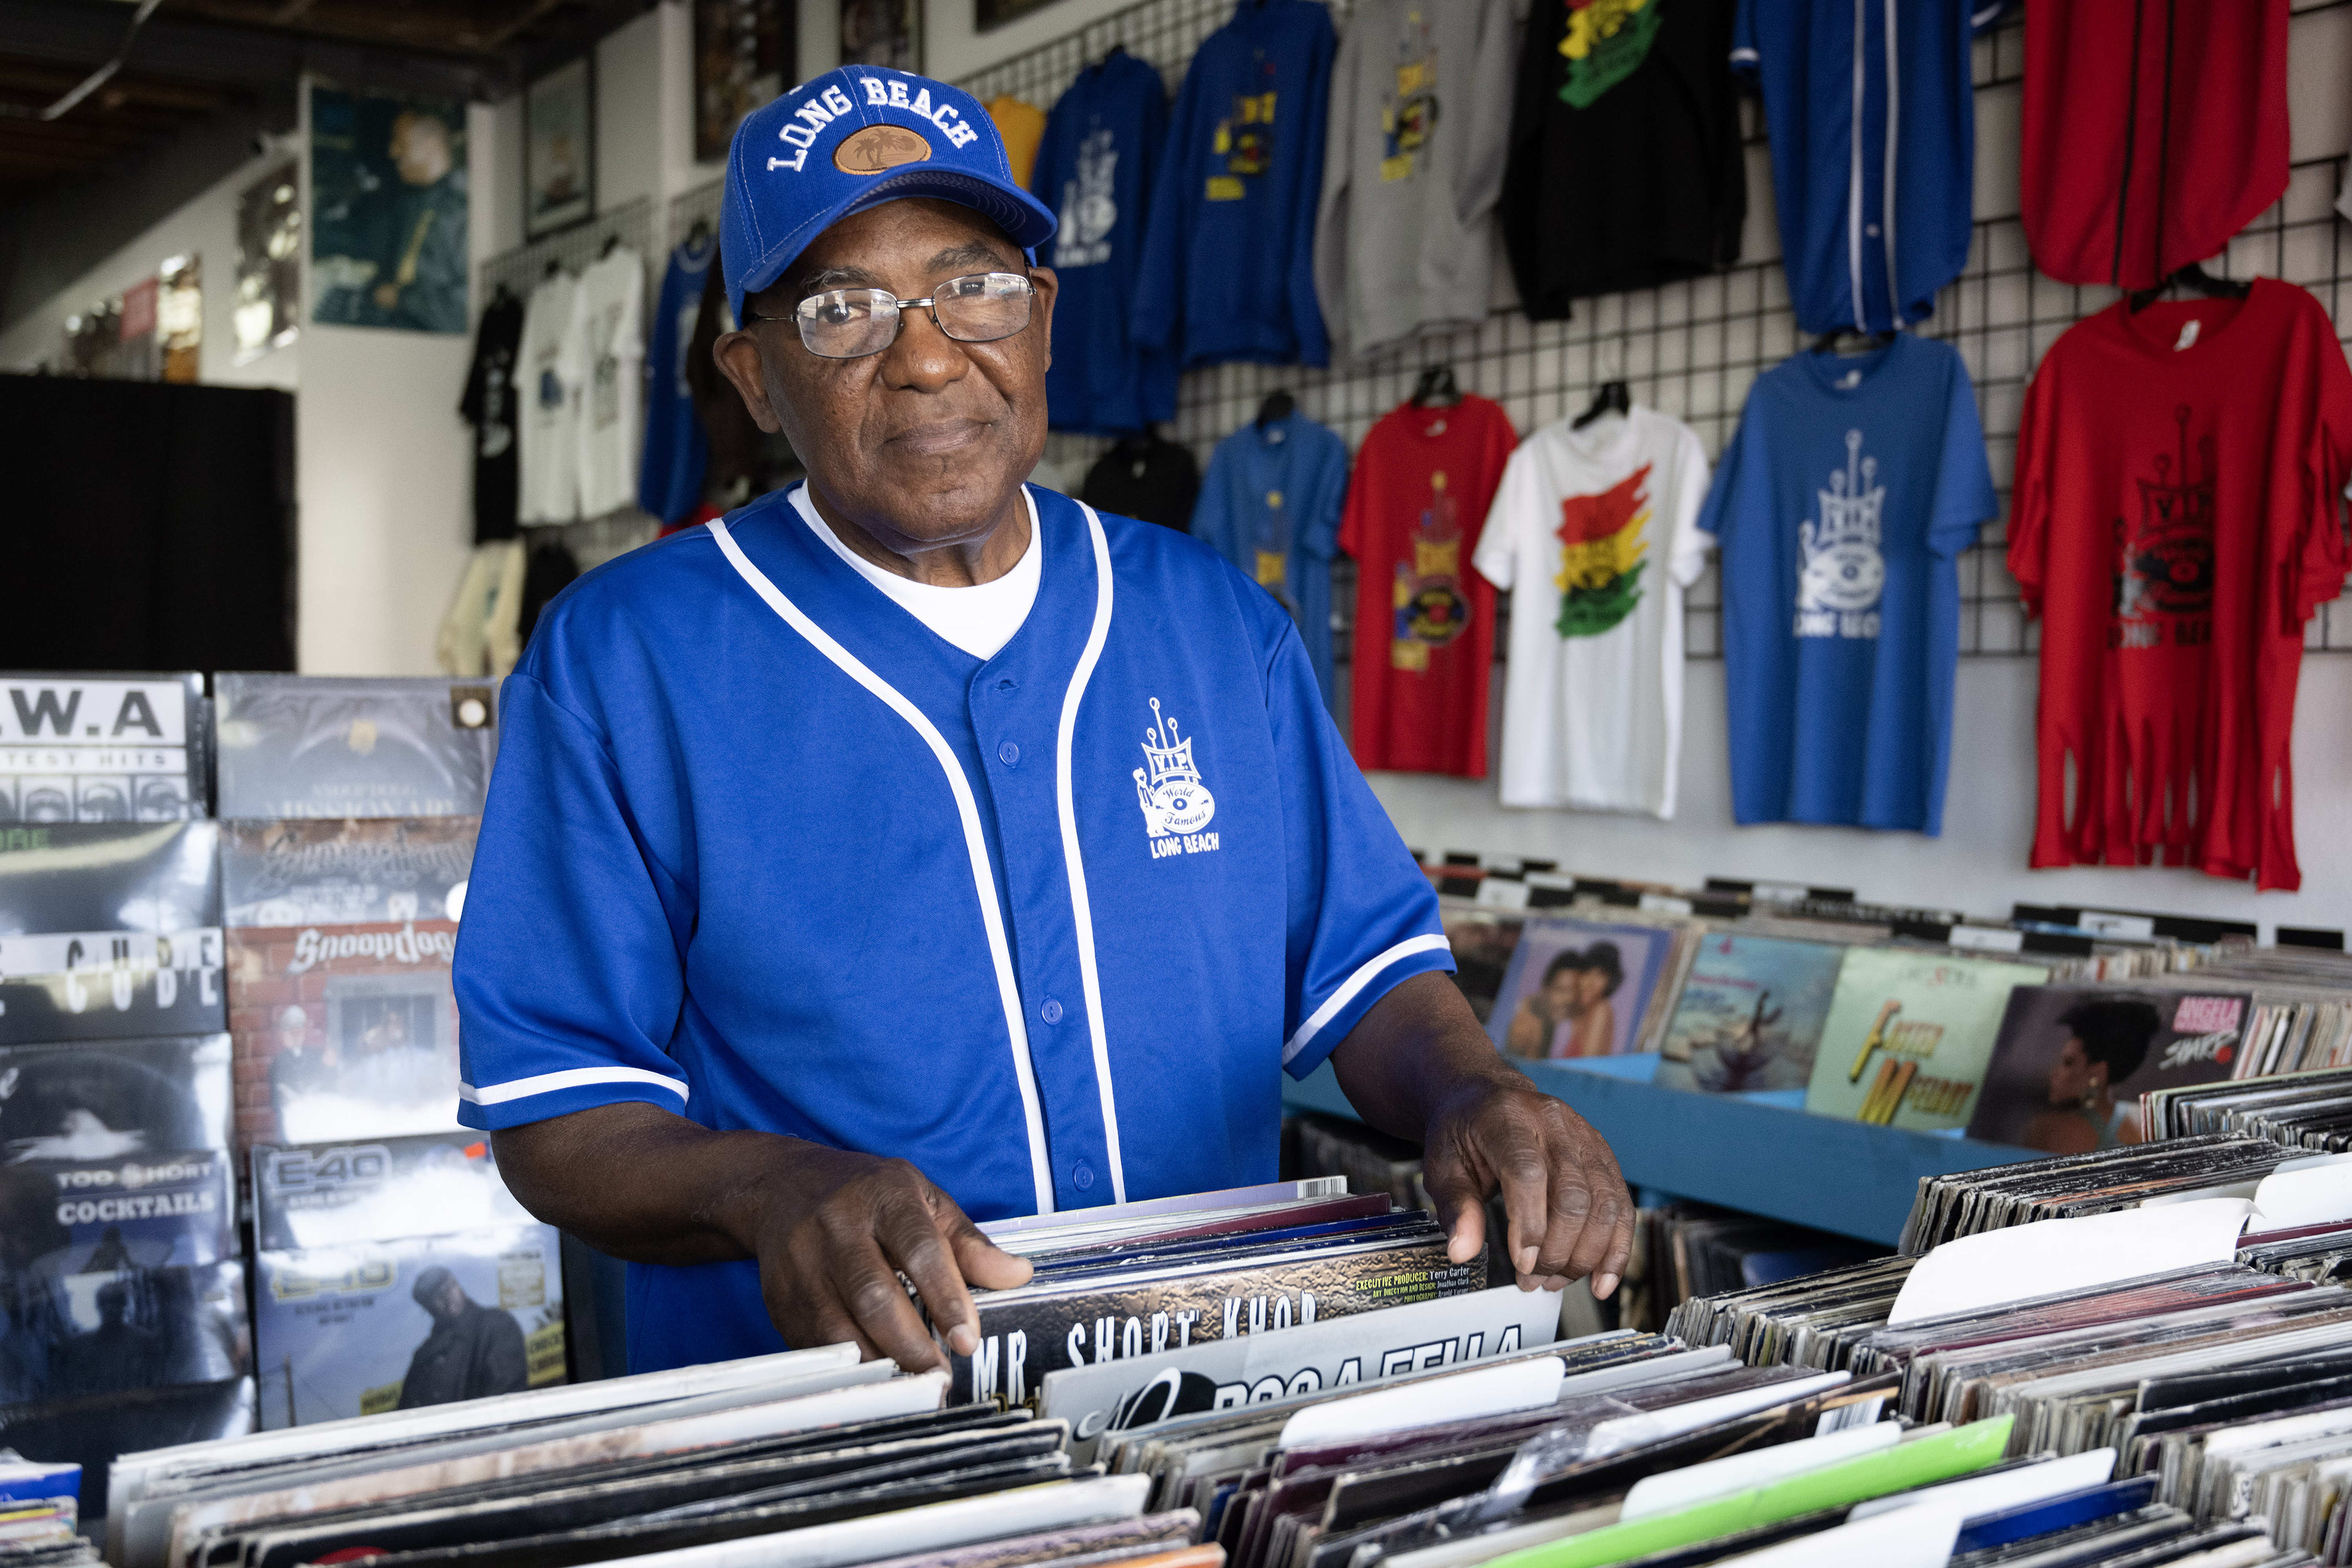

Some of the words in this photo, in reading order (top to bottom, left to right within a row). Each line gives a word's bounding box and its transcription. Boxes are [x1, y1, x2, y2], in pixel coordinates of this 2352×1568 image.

[767, 85, 852, 172] LONG
[860, 77, 978, 149] BEACH
[0, 689, 163, 737] W.A
[99, 752, 166, 765] HITS
[1163, 785, 1195, 799] World
[1165, 810, 1205, 826] Famous
[1150, 836, 1181, 858] LONG
[1183, 832, 1219, 854] BEACH
[57, 1170, 115, 1189] TOO
[57, 1191, 215, 1225] COCKTAILS
[1356, 1276, 1392, 1291] EXECUTIVE
[1394, 1271, 1428, 1285] PRODUCER:
[1430, 1270, 1448, 1280] Terry
[1449, 1266, 1470, 1277] Carter
[1373, 1290, 1382, 1298] ART
[1384, 1285, 1408, 1296] DIRECTION
[1409, 1284, 1418, 1293] AND
[1419, 1281, 1436, 1292] DESIGN:
[1437, 1279, 1457, 1289] Jonathan
[1457, 1277, 1469, 1285] Clark
[1404, 1292, 1437, 1303] PHOTOGRAPHY:
[972, 1329, 1027, 1405] MR
[1067, 1309, 1200, 1367] SHORT
